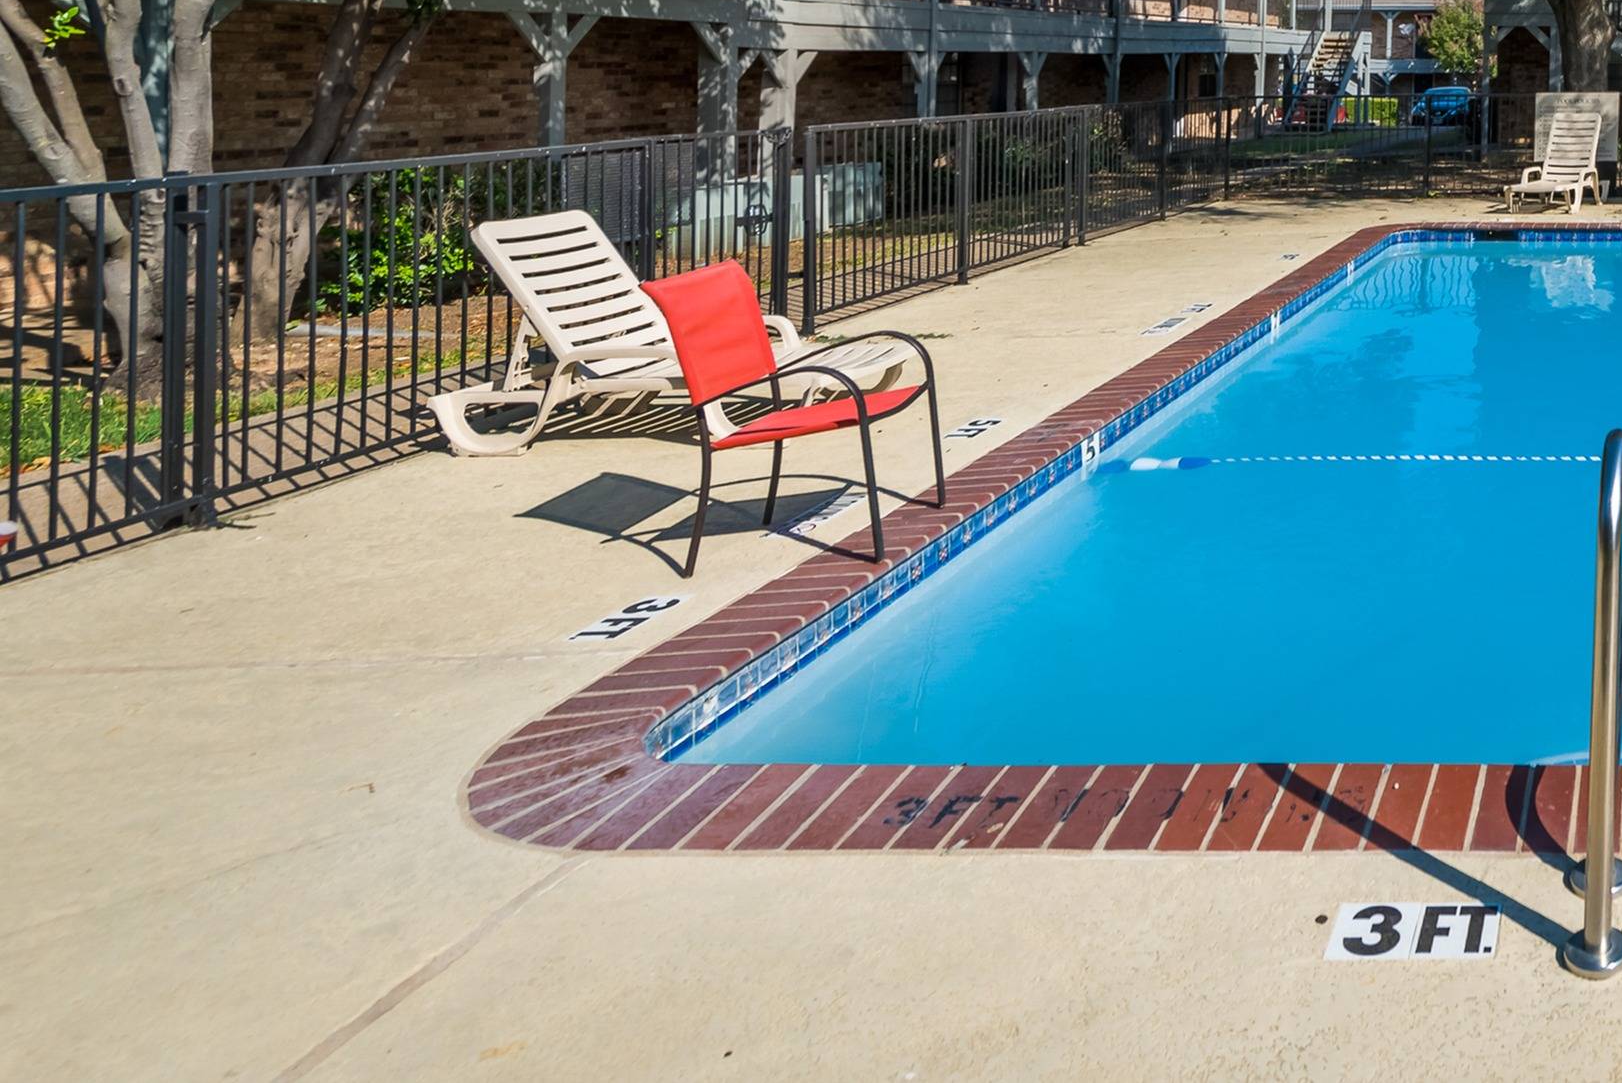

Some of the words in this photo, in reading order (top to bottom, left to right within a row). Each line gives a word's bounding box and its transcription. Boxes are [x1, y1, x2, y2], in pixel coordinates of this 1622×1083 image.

[1086, 436, 1096, 462] 5
[622, 598, 680, 614] 3
[883, 795, 929, 826] 3
[1342, 905, 1403, 956] 3
